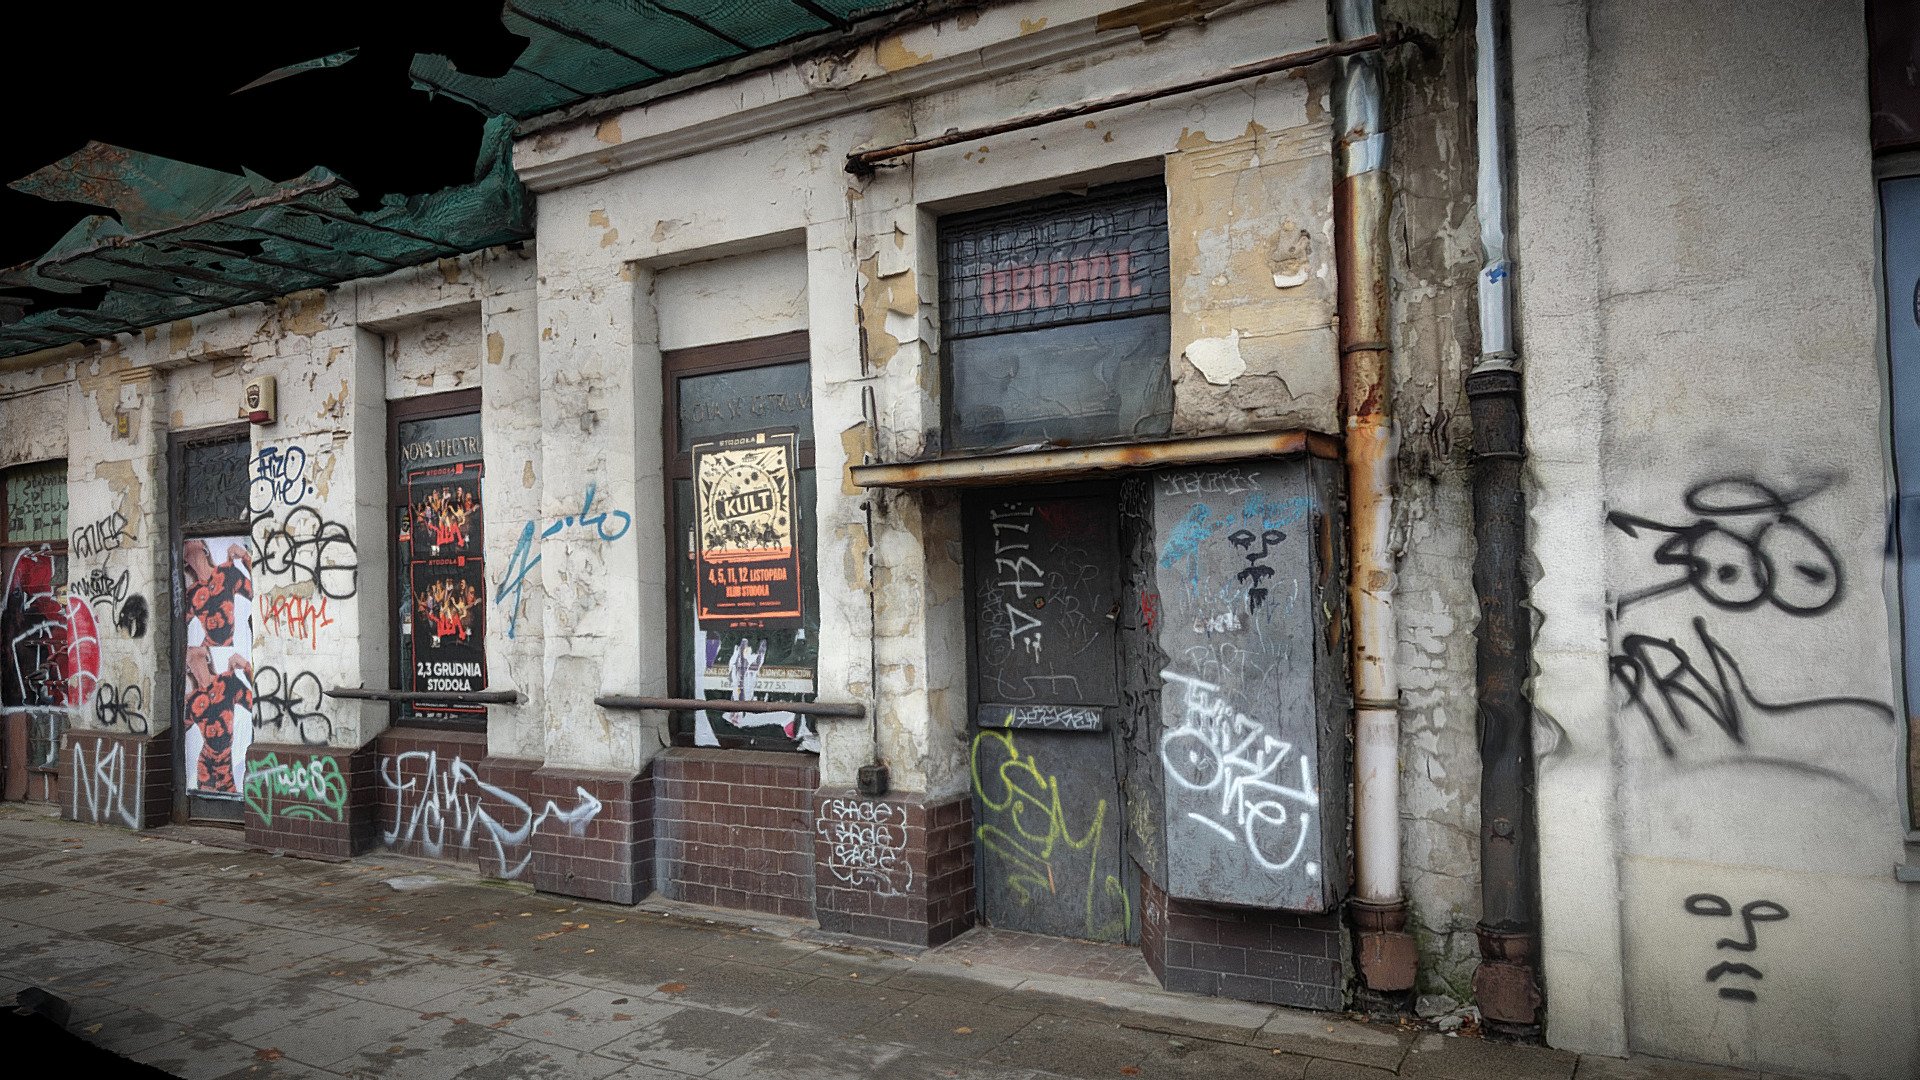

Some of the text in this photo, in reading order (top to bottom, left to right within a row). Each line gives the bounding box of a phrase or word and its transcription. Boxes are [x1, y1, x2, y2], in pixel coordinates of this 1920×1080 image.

[401, 442, 433, 461] NOVA
[723, 492, 770, 517] KULT
[709, 566, 787, 586] 4, 5, 11, 12 LISTOPADA
[725, 586, 741, 598] KLUB
[417, 662, 482, 678] 2,3 GRUDNIA
[427, 679, 471, 691] STODOŁA
